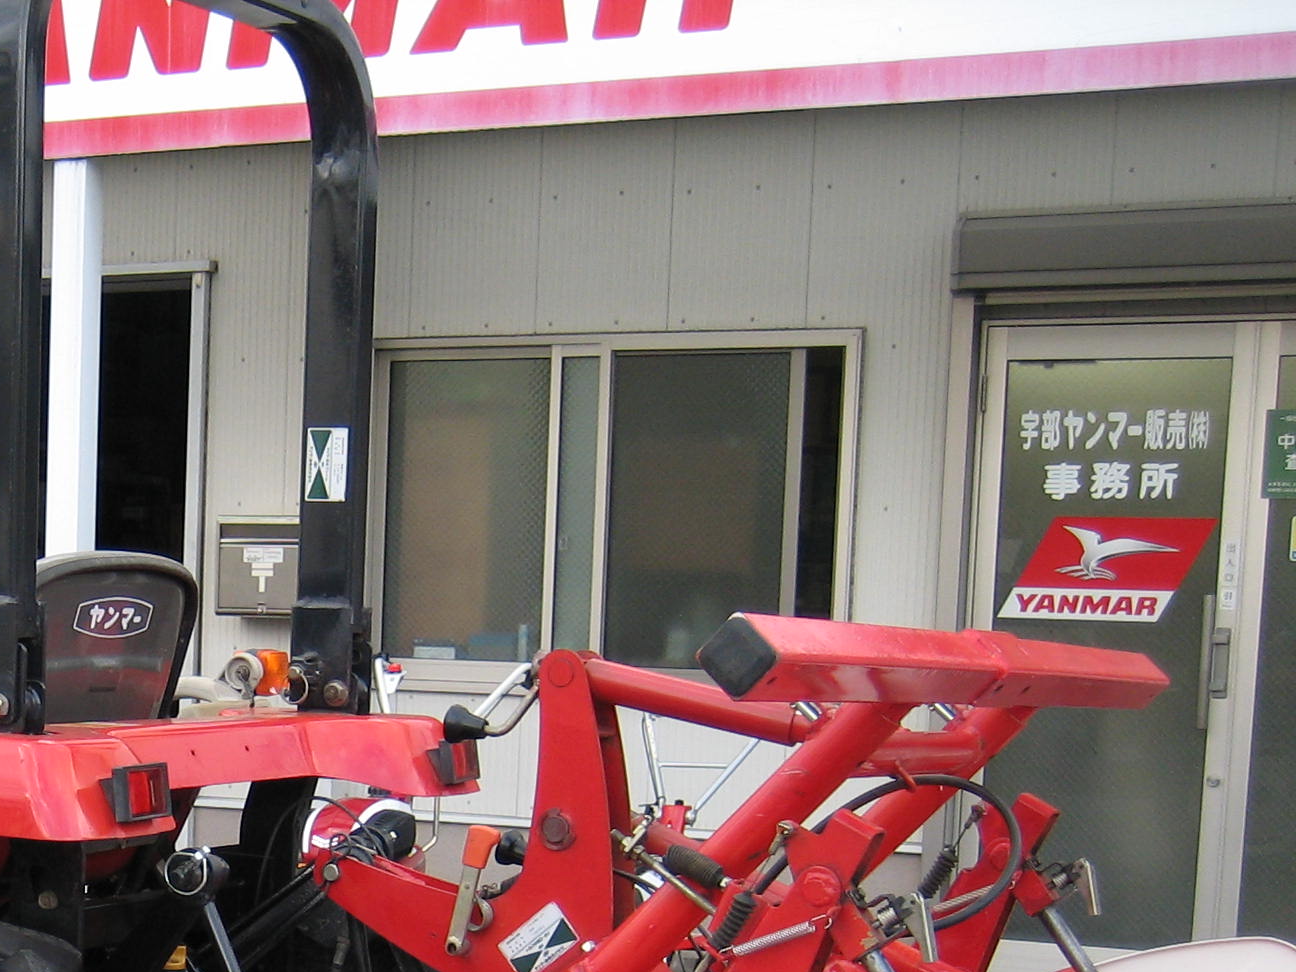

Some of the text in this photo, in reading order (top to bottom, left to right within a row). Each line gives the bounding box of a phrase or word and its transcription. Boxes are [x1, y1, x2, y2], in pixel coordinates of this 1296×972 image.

[1042, 461, 1180, 500] 事務所
[89, 603, 142, 630] ヤンマー
[1015, 593, 1158, 616] YANMAR
